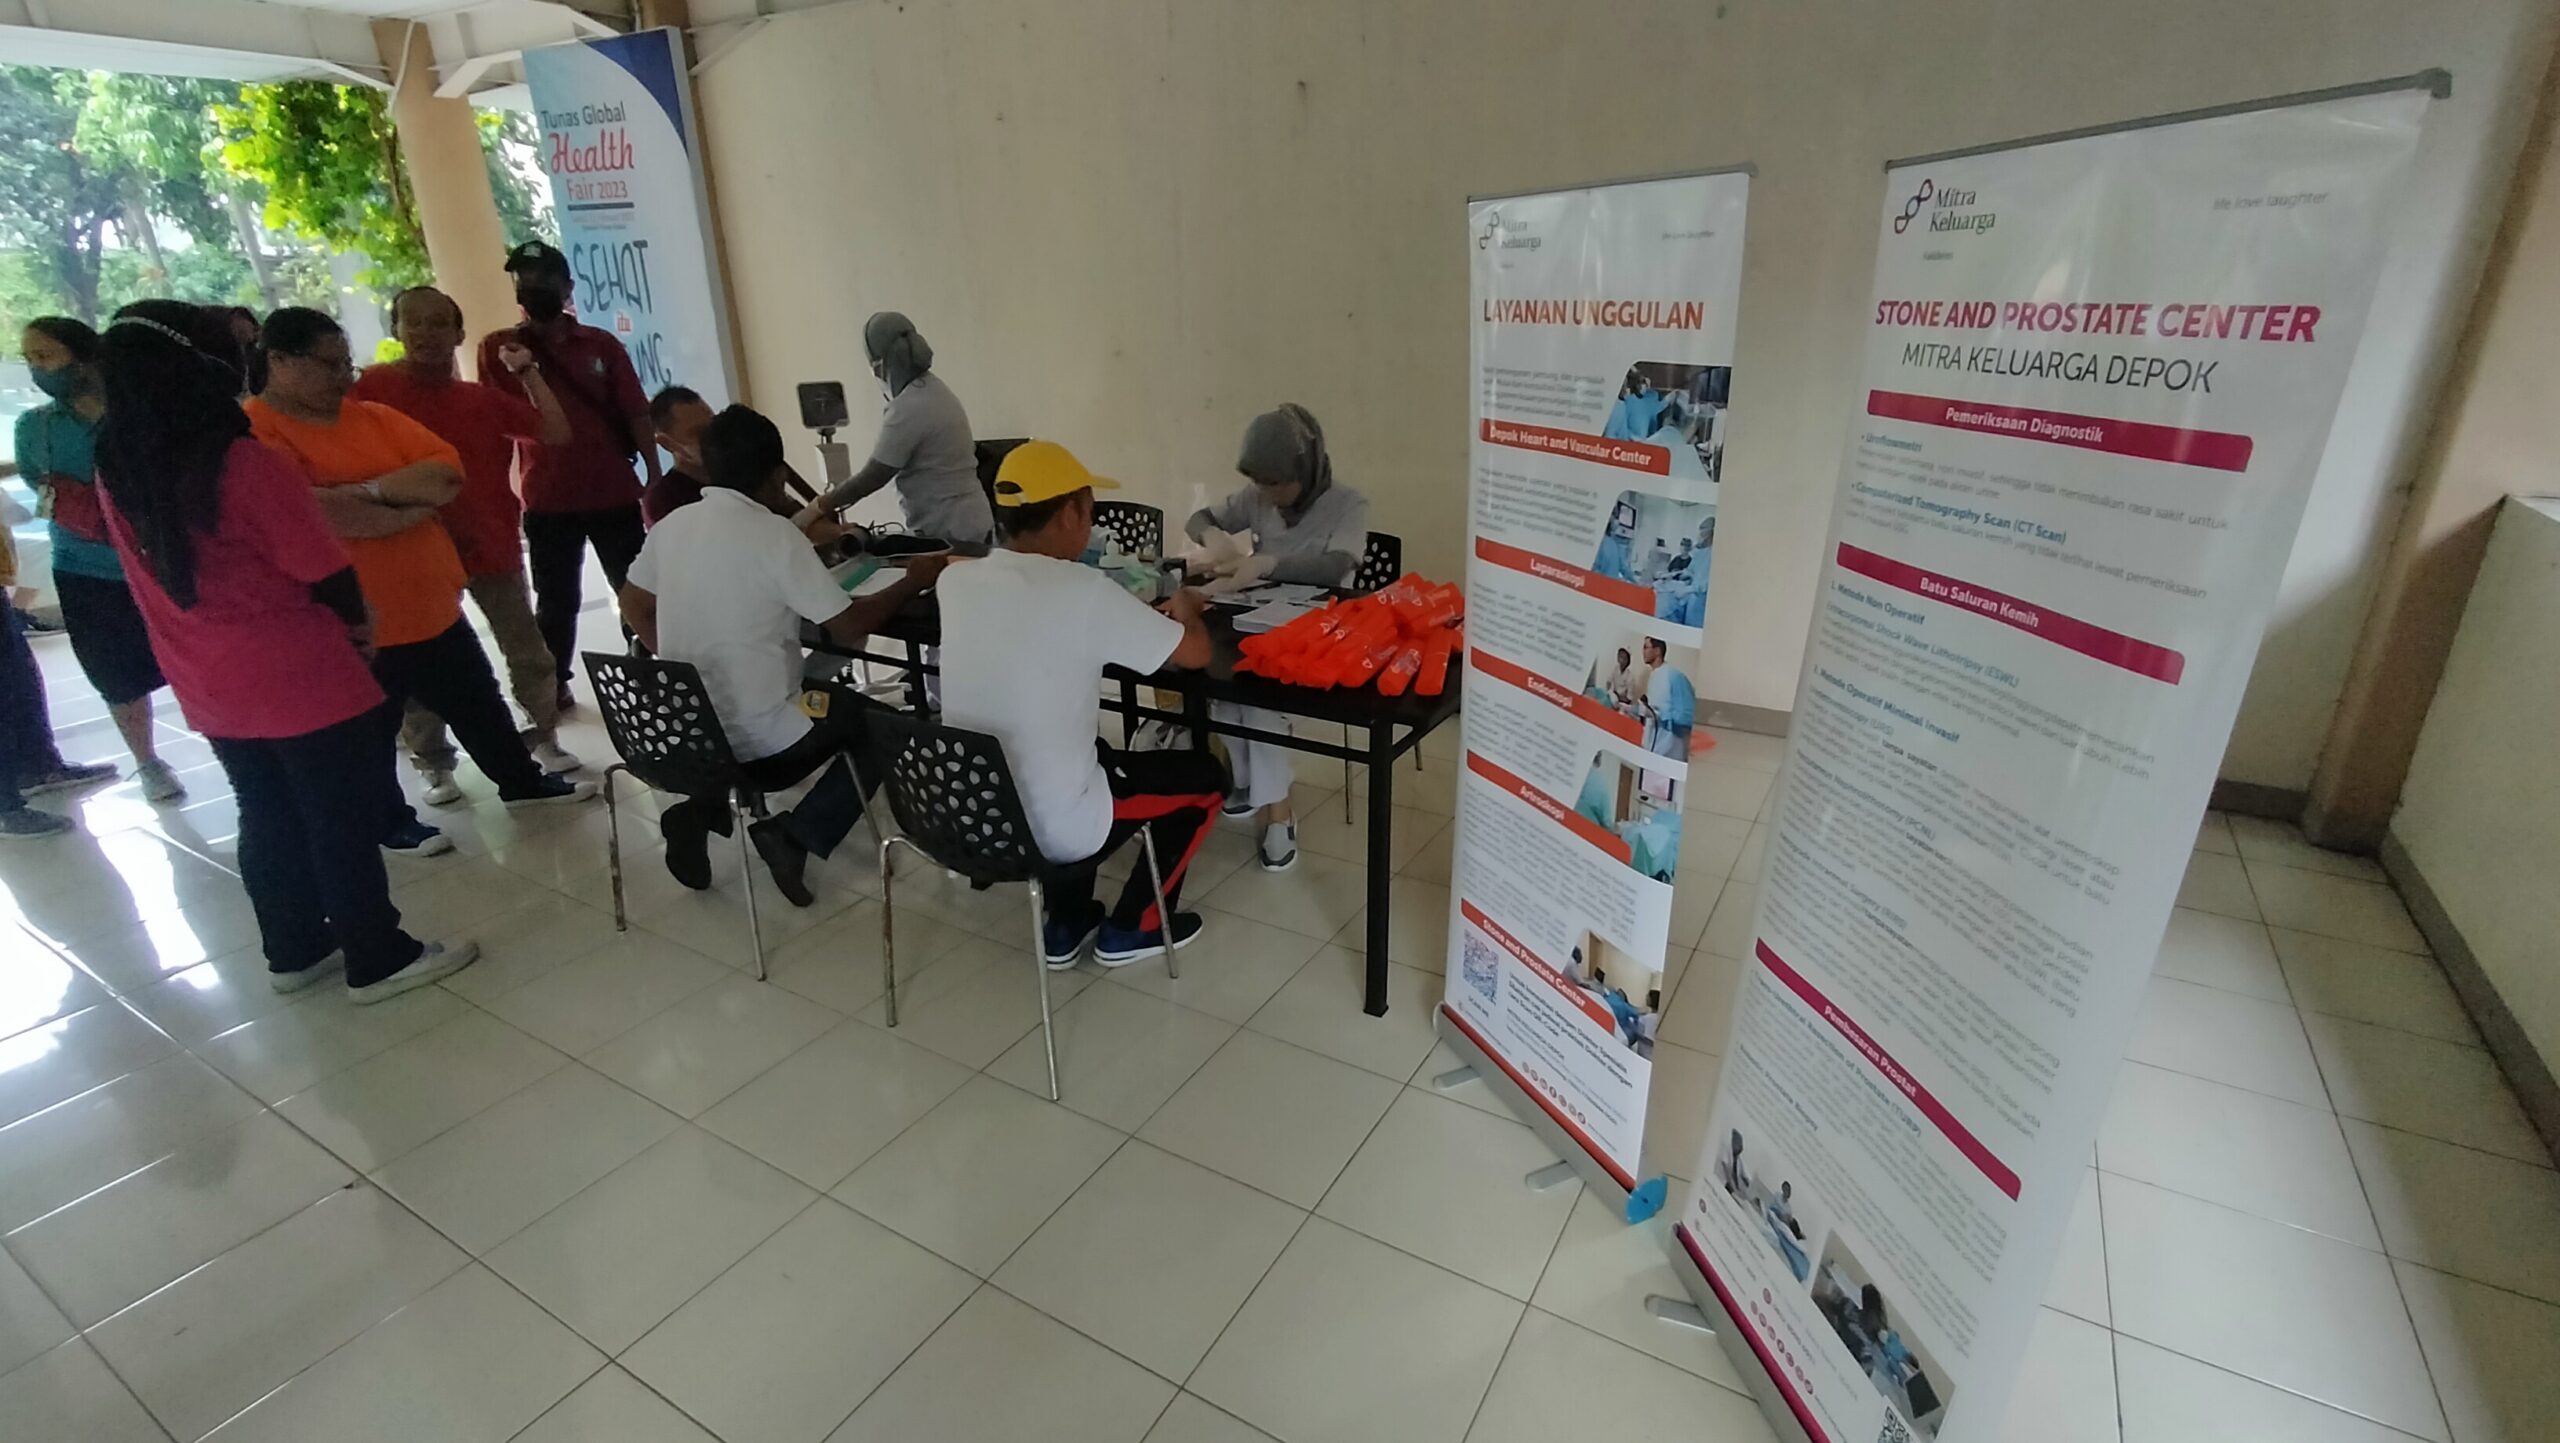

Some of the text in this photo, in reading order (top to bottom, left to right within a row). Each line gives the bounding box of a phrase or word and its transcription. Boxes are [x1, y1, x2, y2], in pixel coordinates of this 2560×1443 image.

[541, 101, 626, 129] Tunas Global
[549, 128, 635, 173] Health
[567, 177, 628, 201] Fair 2023
[1935, 187, 1977, 208] Mitra
[1929, 210, 1996, 235] Keluarga
[573, 239, 653, 315] SEHAT
[1483, 299, 1704, 330] LAYANAN UNGGULAN
[1875, 301, 2322, 342] STONE AND PROSTATE CENTER
[1902, 342, 2220, 394] MITRA KELUARGA DEPOK
[1945, 406, 2104, 444] Pemeriksaan Diagnostik
[1489, 426, 1652, 466] Depok Heart and Vascular Center
[1915, 496, 1982, 525] Tomography
[1983, 513, 2011, 530] Scan
[2013, 519, 2035, 536] (CT
[2036, 524, 2067, 545] Scan)
[2155, 506, 2185, 523] sakit
[1920, 577, 2040, 629] Batu Saluran Kemih
[2125, 569, 2208, 600] pemeriksaan
[1884, 602, 1926, 626] Operatif
[1883, 700, 1925, 728] Minimal
[1925, 719, 1961, 744] Invasif
[2089, 872, 2116, 891] atau
[1483, 919, 1587, 1008] Stone and Prostate Center
[1824, 1004, 1881, 1062] Pembesaran
[1879, 1055, 1918, 1098] Prostat
